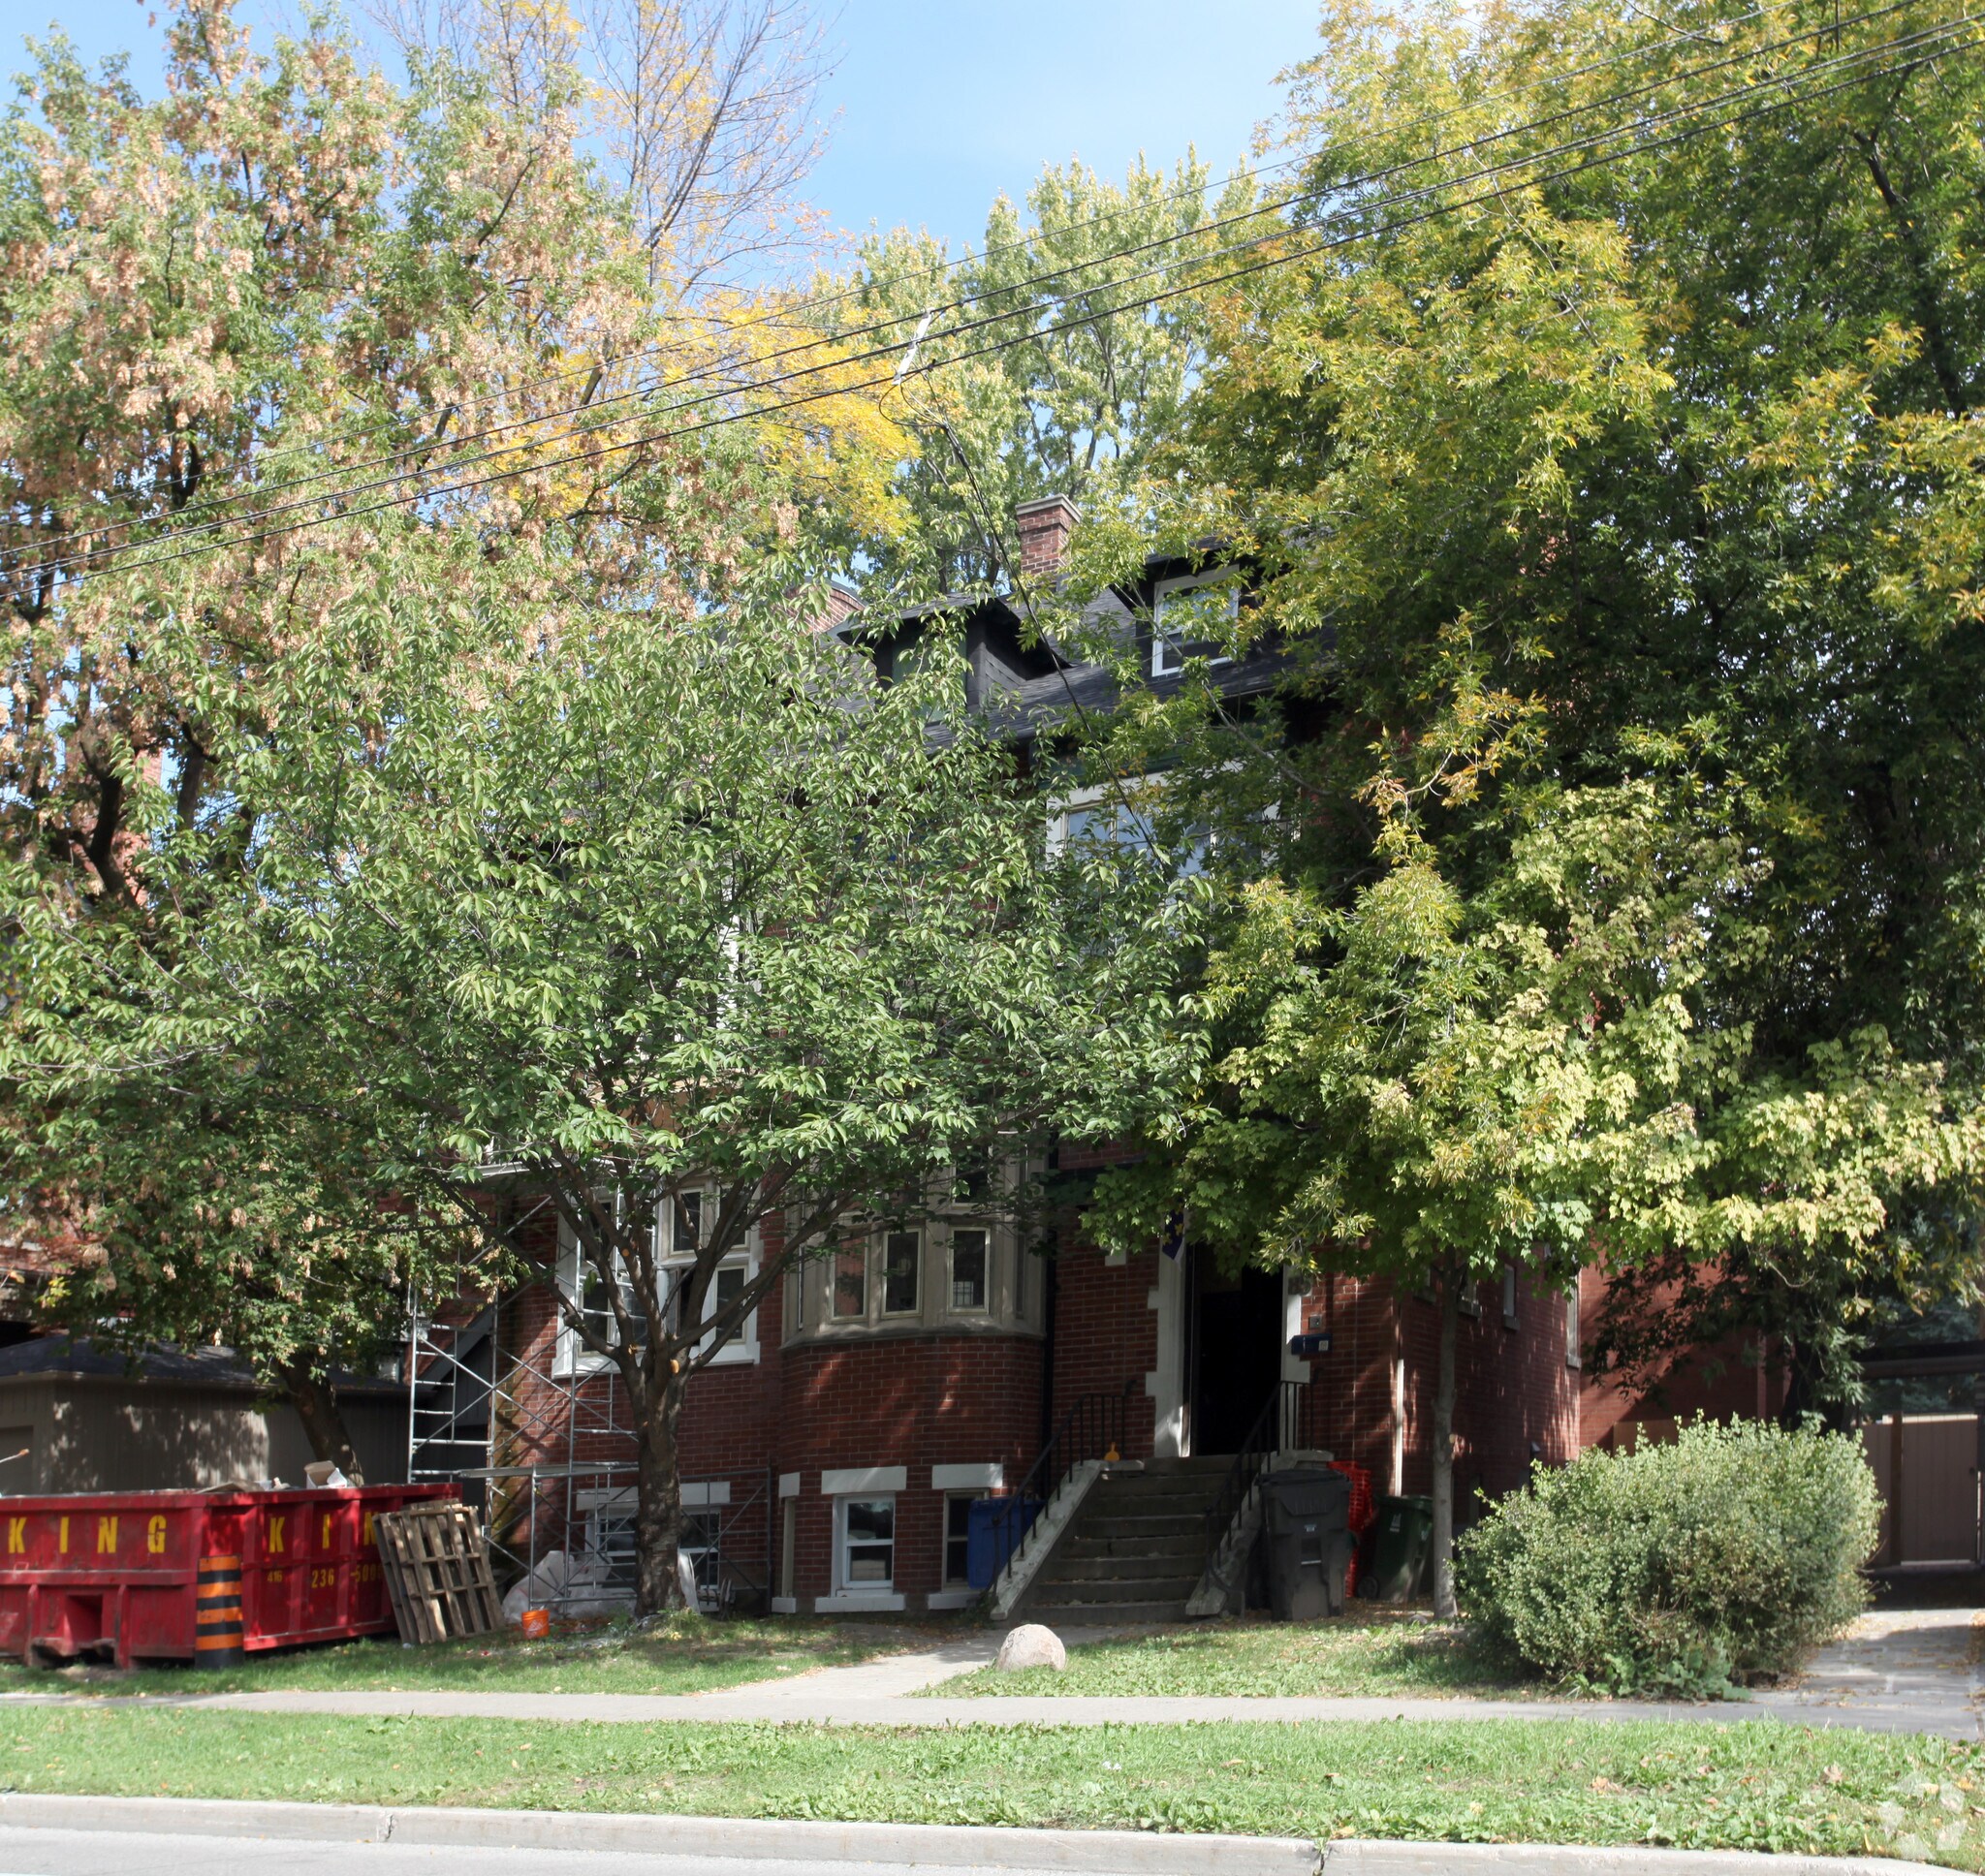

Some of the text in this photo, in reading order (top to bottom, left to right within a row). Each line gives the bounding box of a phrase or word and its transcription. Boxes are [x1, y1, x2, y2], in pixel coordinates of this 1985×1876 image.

[8, 1515, 167, 1554] KING
[267, 1571, 283, 1582] 416
[311, 1569, 335, 1588] 236
